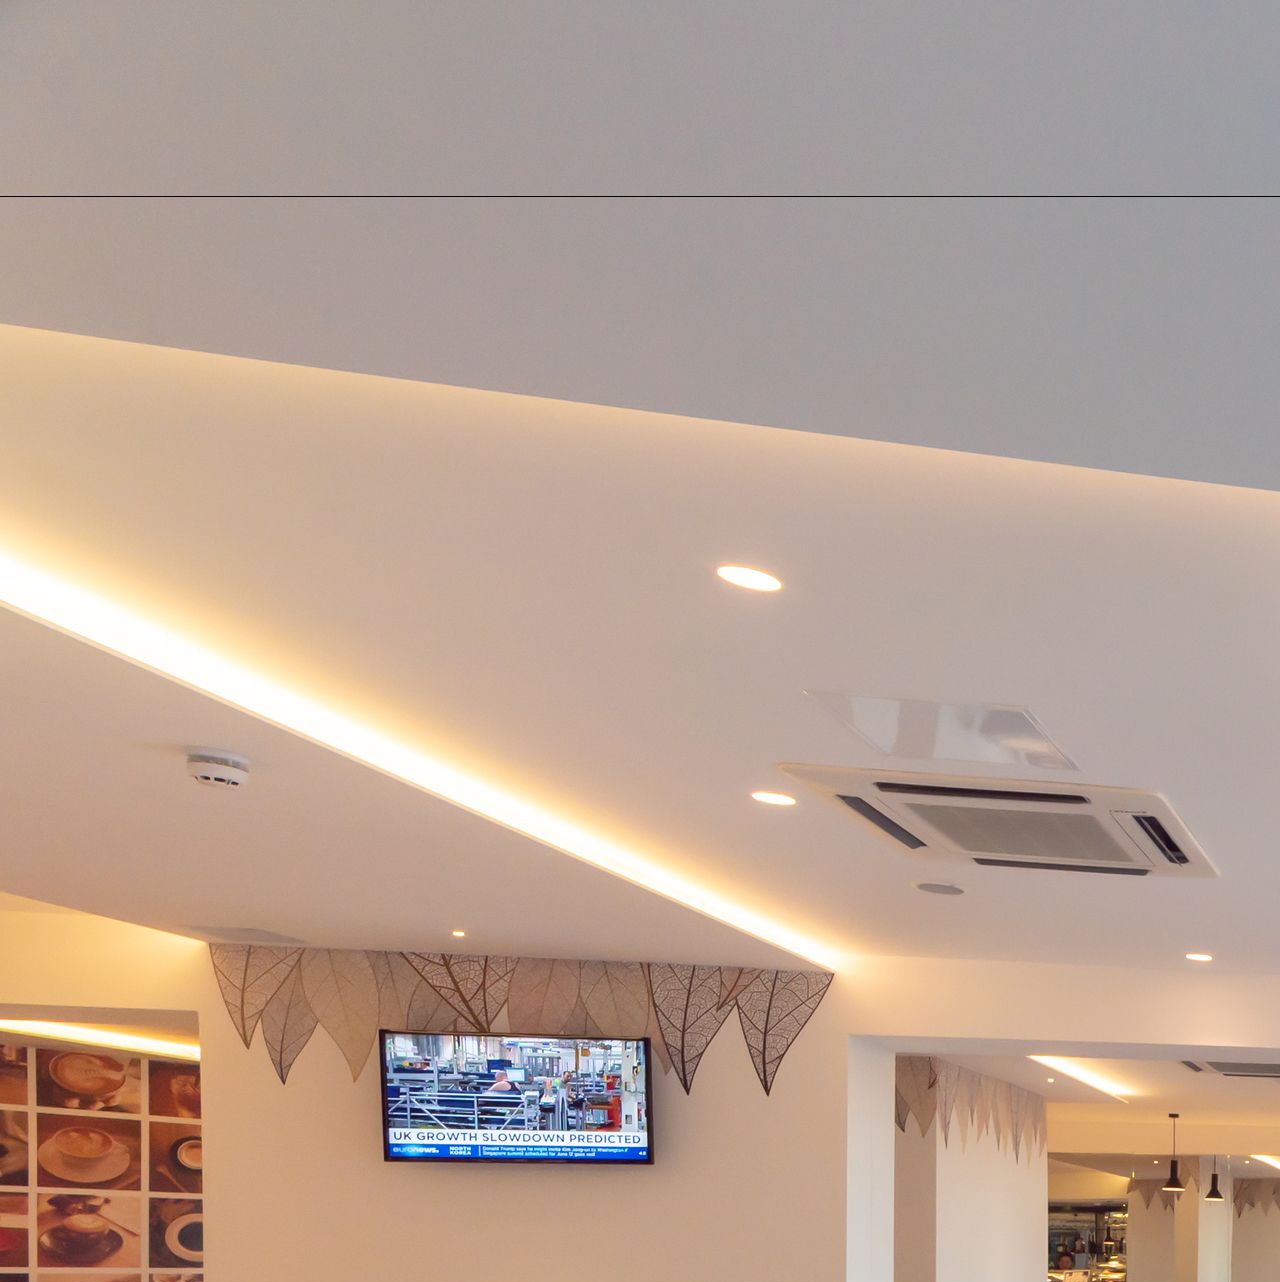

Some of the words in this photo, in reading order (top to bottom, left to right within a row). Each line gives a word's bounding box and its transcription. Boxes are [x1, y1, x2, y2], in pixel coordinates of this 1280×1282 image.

[393, 1131, 412, 1140] UK
[416, 1131, 477, 1141] GROWTH
[482, 1132, 565, 1142] SLOWDOWN
[570, 1134, 640, 1144] PREDICTED
